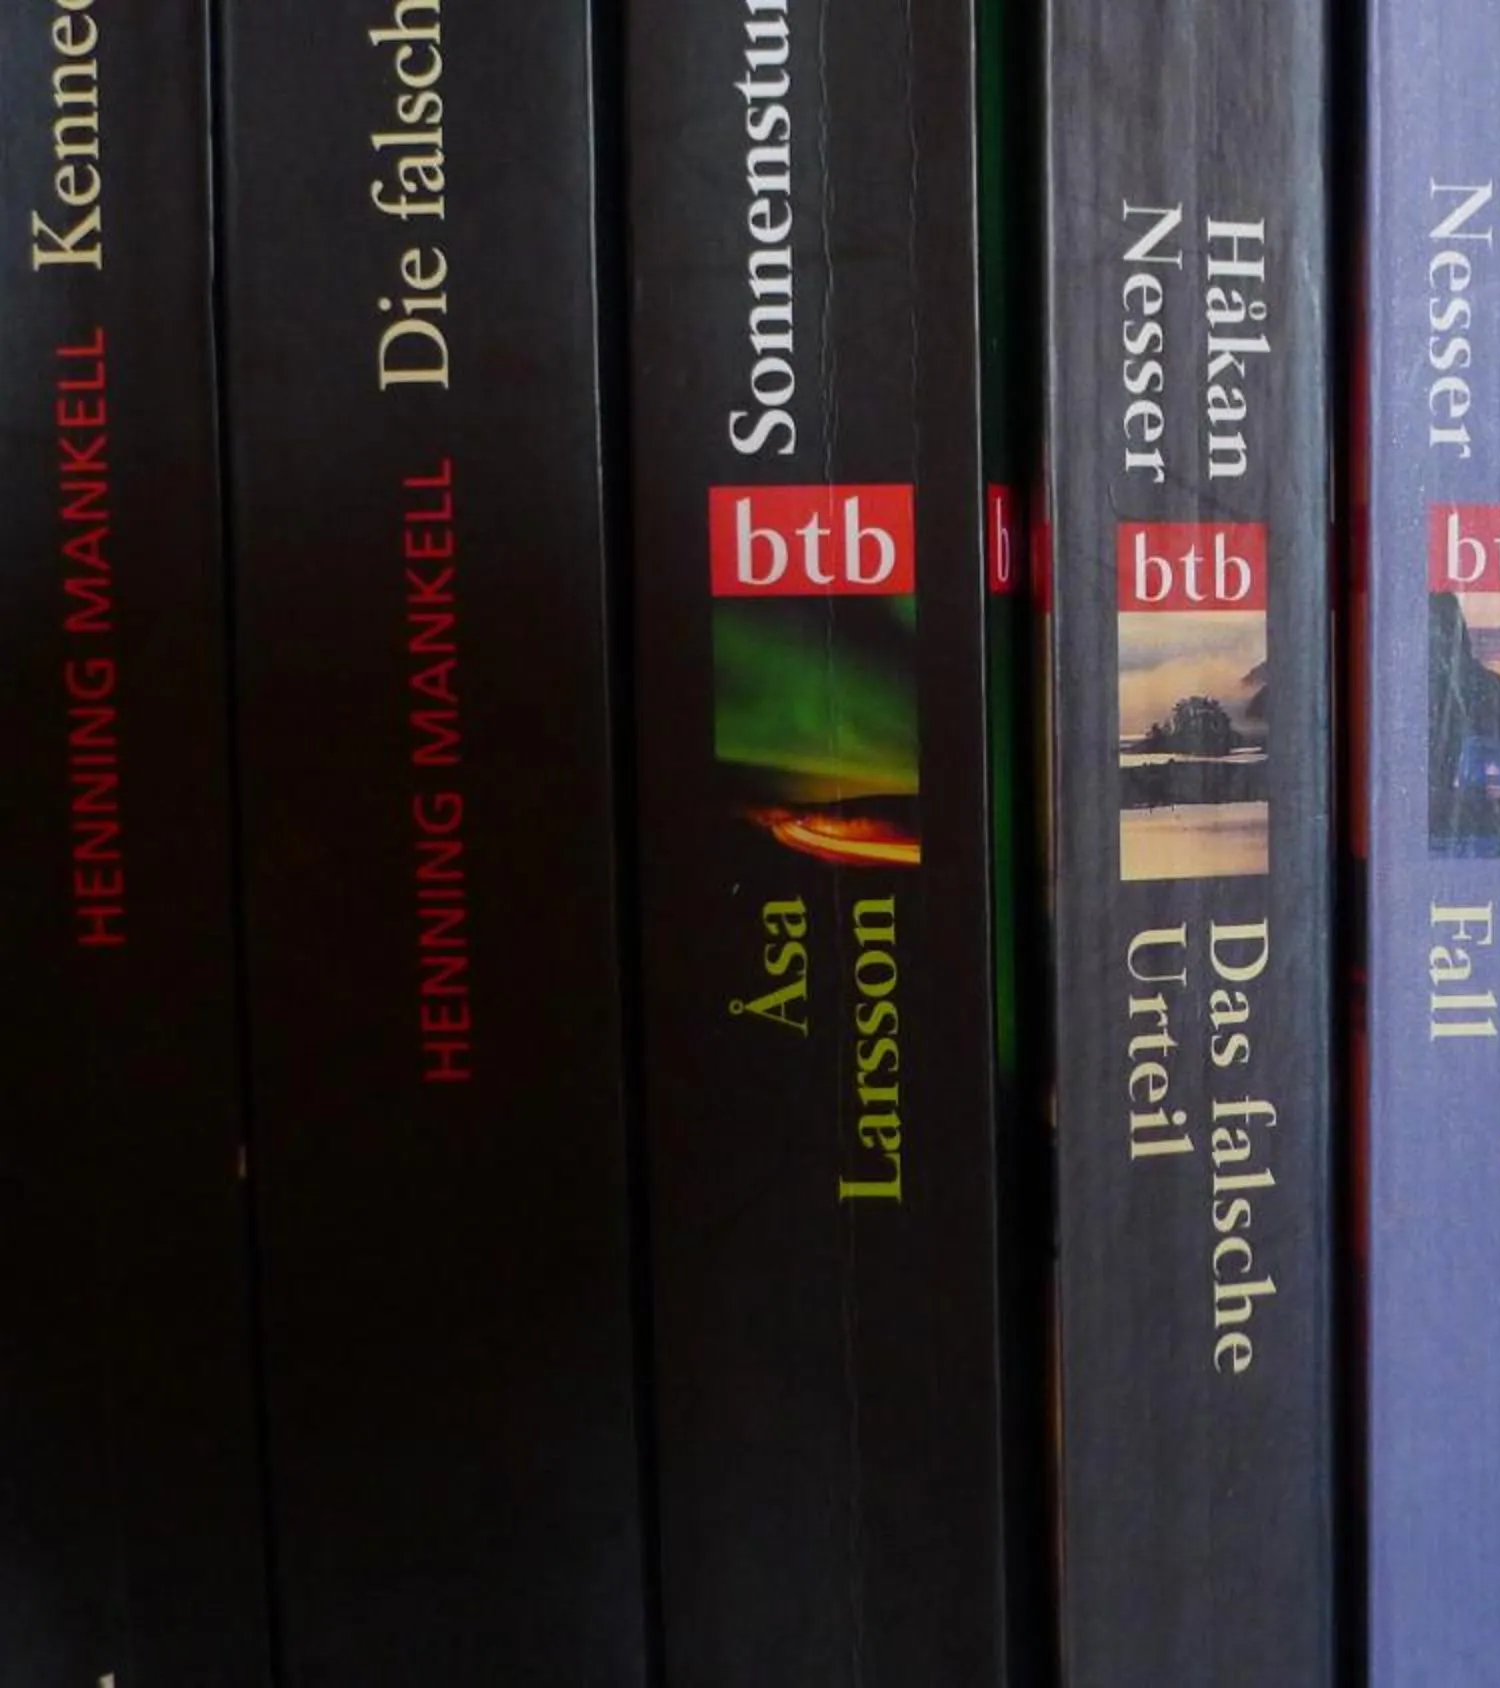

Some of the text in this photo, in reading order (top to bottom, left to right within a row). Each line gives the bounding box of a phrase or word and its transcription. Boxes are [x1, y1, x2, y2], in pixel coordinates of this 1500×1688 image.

[378, 247, 450, 391] Die
[1122, 198, 1184, 484] Nesser
[1205, 215, 1272, 480] Håkan
[1428, 177, 1494, 460] Nesser
[31, 0, 127, 947] HENNING MANKELL Kenne
[734, 495, 897, 586] btb
[1133, 531, 1252, 602] btb
[402, 457, 460, 767] MANKELL
[413, 789, 473, 1083] HENNING
[728, 896, 809, 1036] Åsa
[839, 896, 903, 1203] Larsson
[1126, 922, 1195, 1160] Urteil
[1428, 900, 1498, 1042] Fall
[1209, 917, 1278, 1374] Das falsche
